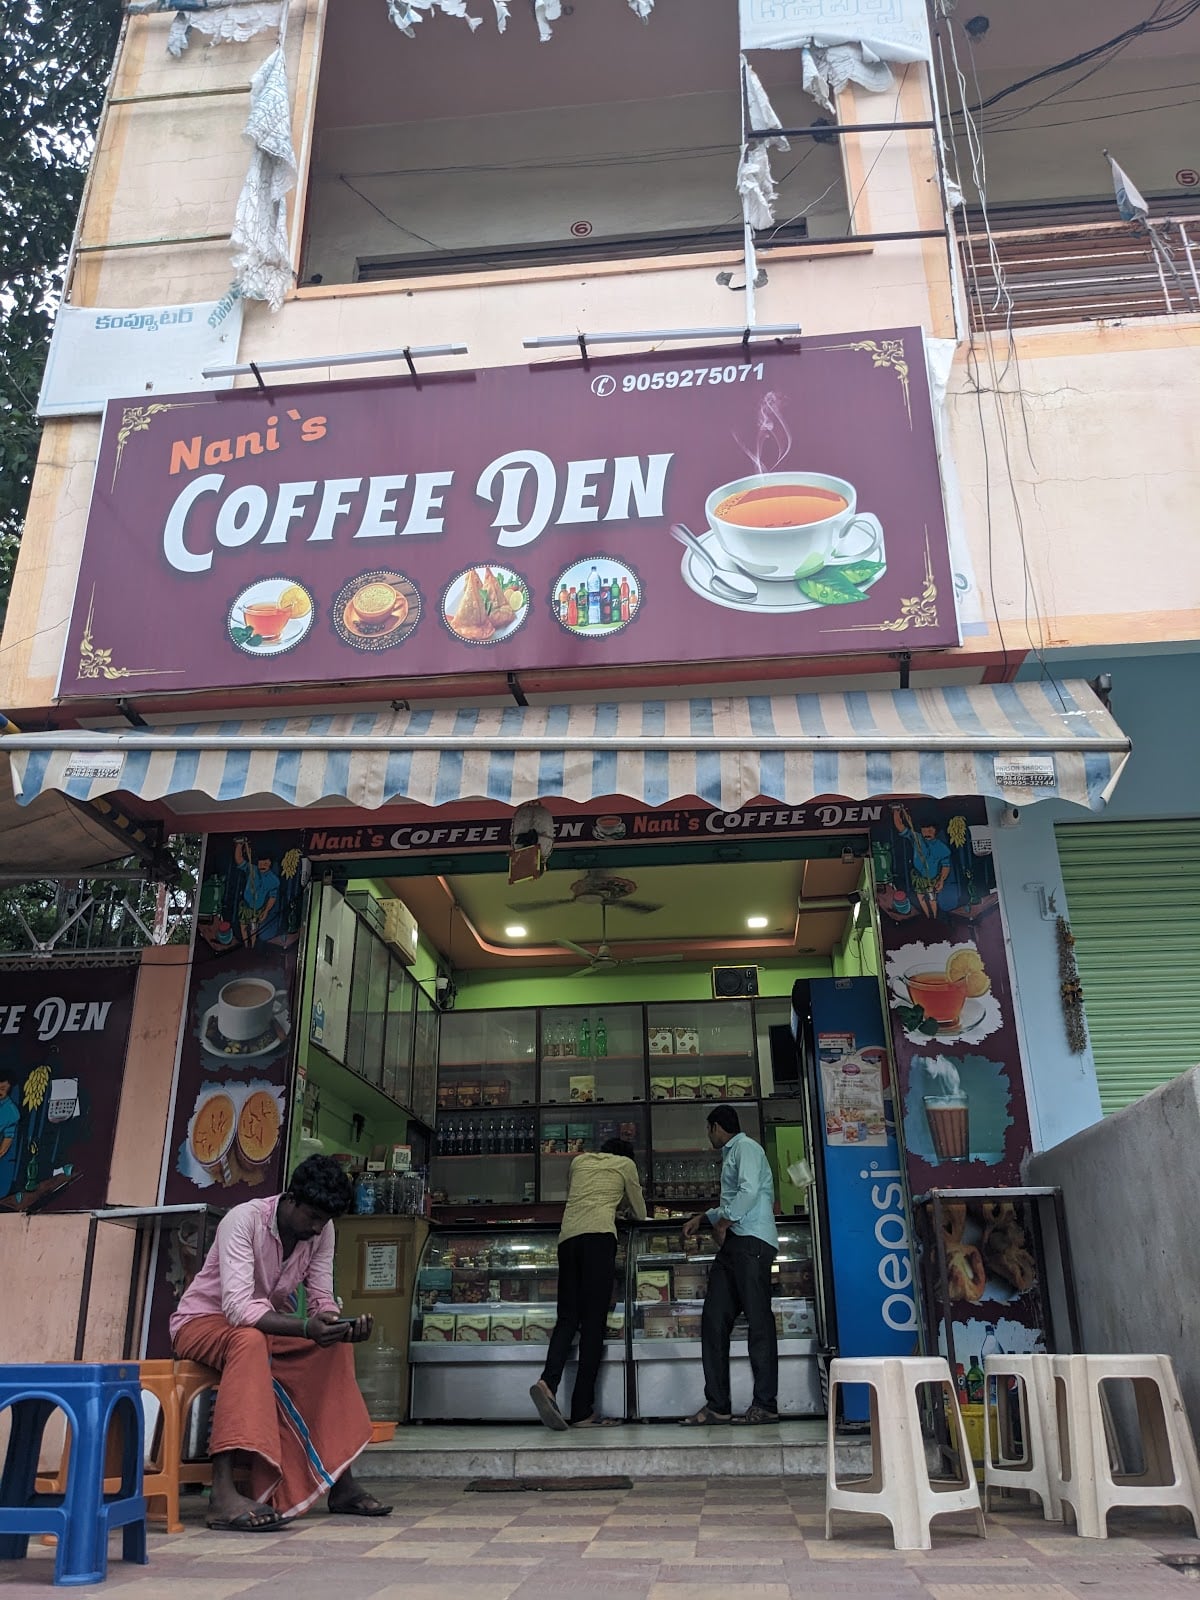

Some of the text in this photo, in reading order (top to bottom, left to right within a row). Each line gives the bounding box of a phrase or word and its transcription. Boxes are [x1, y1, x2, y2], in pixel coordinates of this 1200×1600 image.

[1180, 172, 1195, 184] 5
[574, 223, 588, 235] 6
[622, 363, 764, 392] 9059275071
[163, 450, 675, 573] COFFEE DEN
[706, 811, 806, 833] COFFEE
[815, 806, 882, 827] DEN
[390, 826, 501, 849] COFFEE
[33, 997, 113, 1041] DEN
[860, 1170, 919, 1331] pepsi
